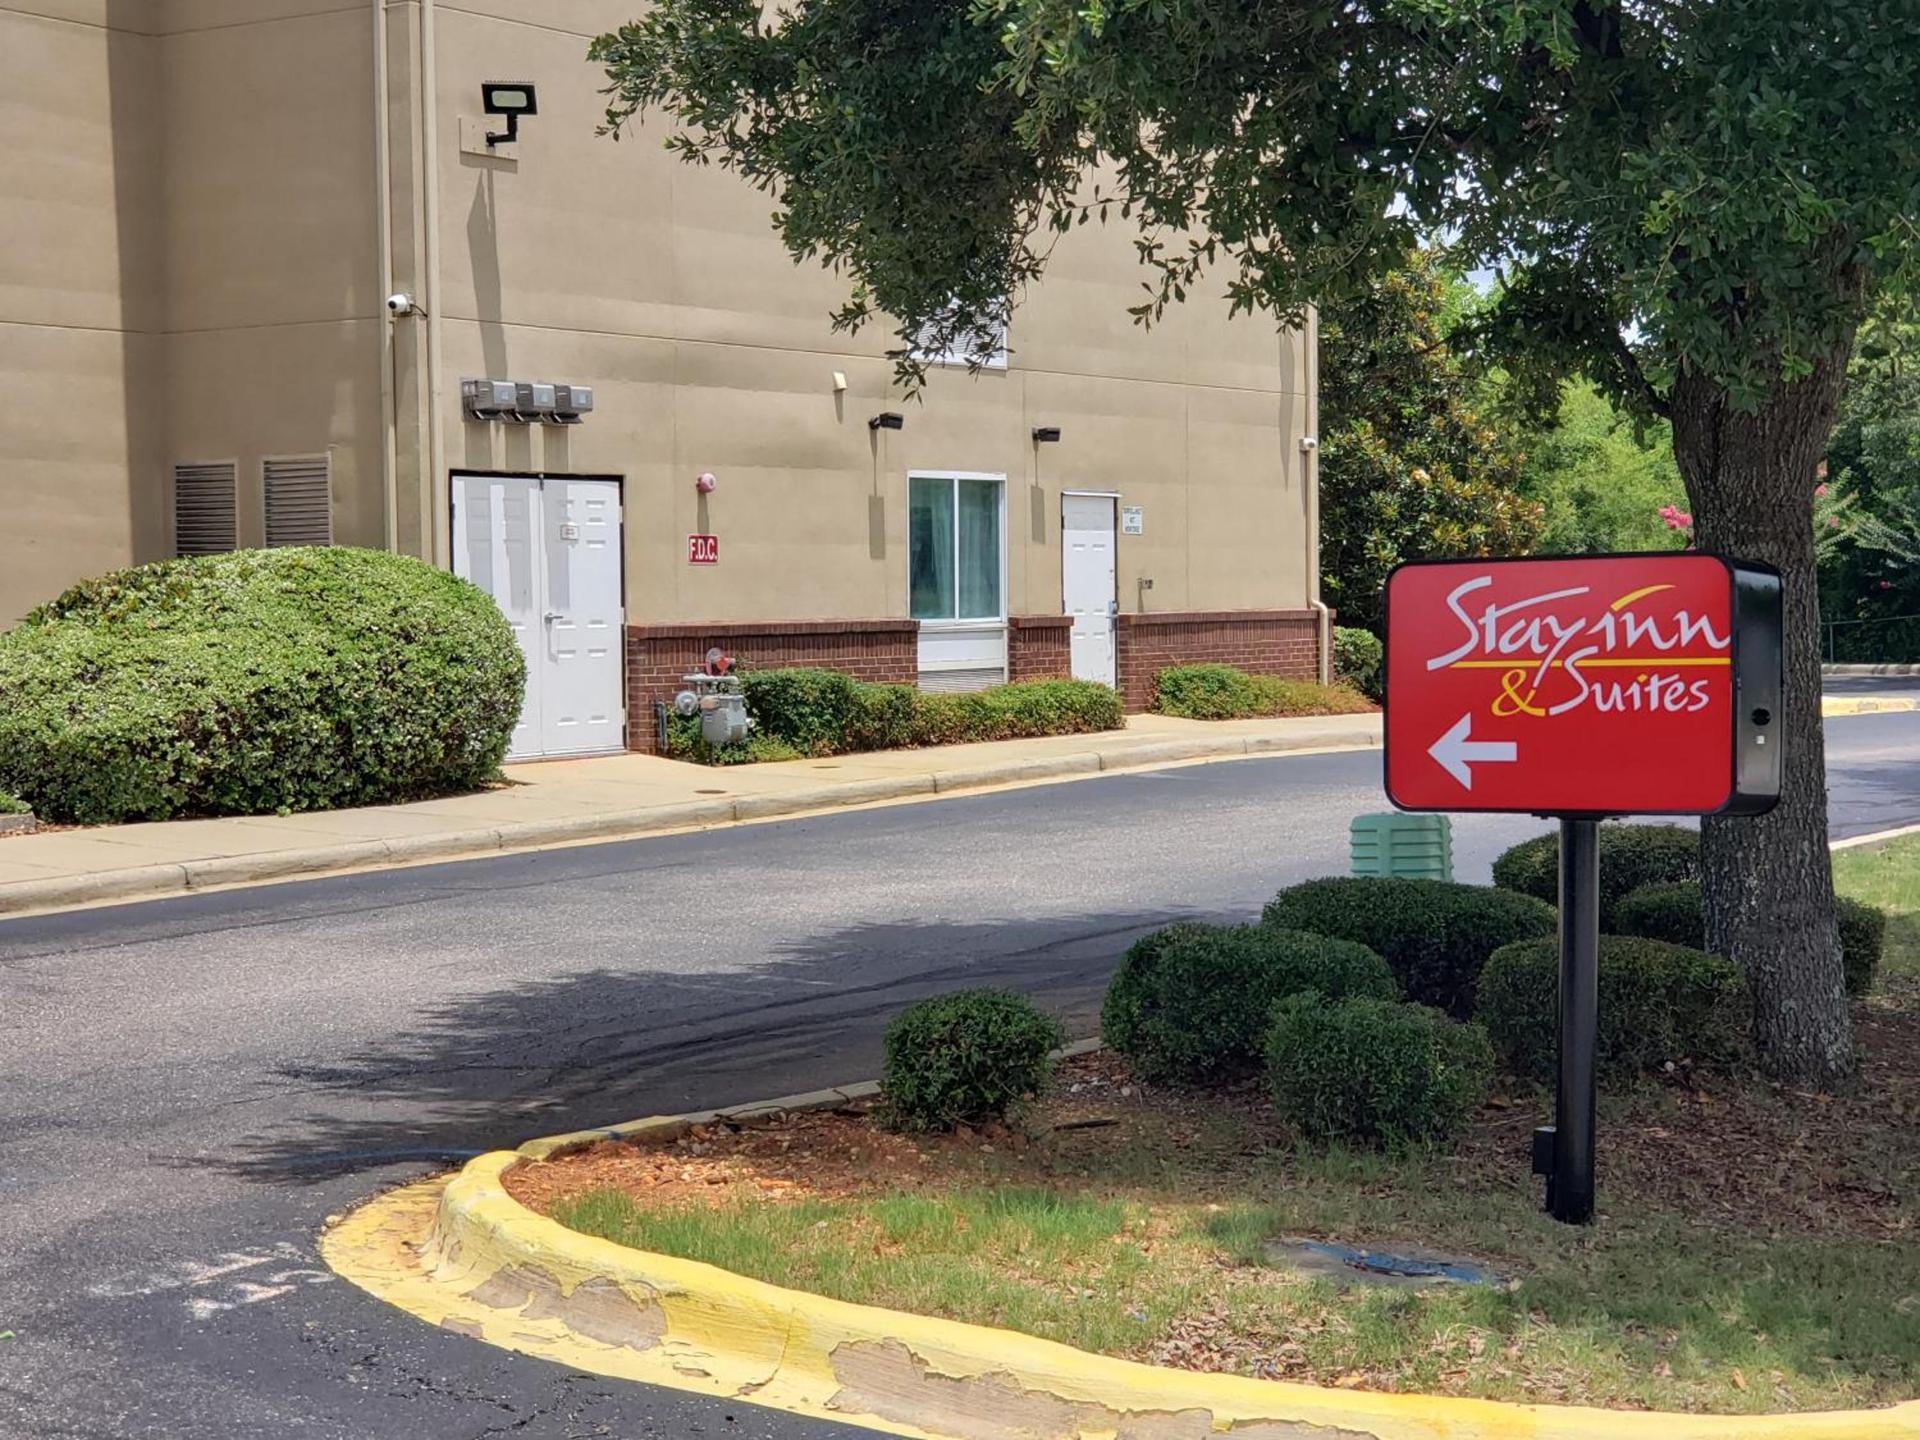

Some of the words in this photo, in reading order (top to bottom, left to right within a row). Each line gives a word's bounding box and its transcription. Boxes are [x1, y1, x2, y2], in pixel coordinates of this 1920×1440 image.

[689, 538, 718, 560] F.D.C.
[1491, 669, 1546, 717] &
[1549, 646, 1709, 716] Suites
